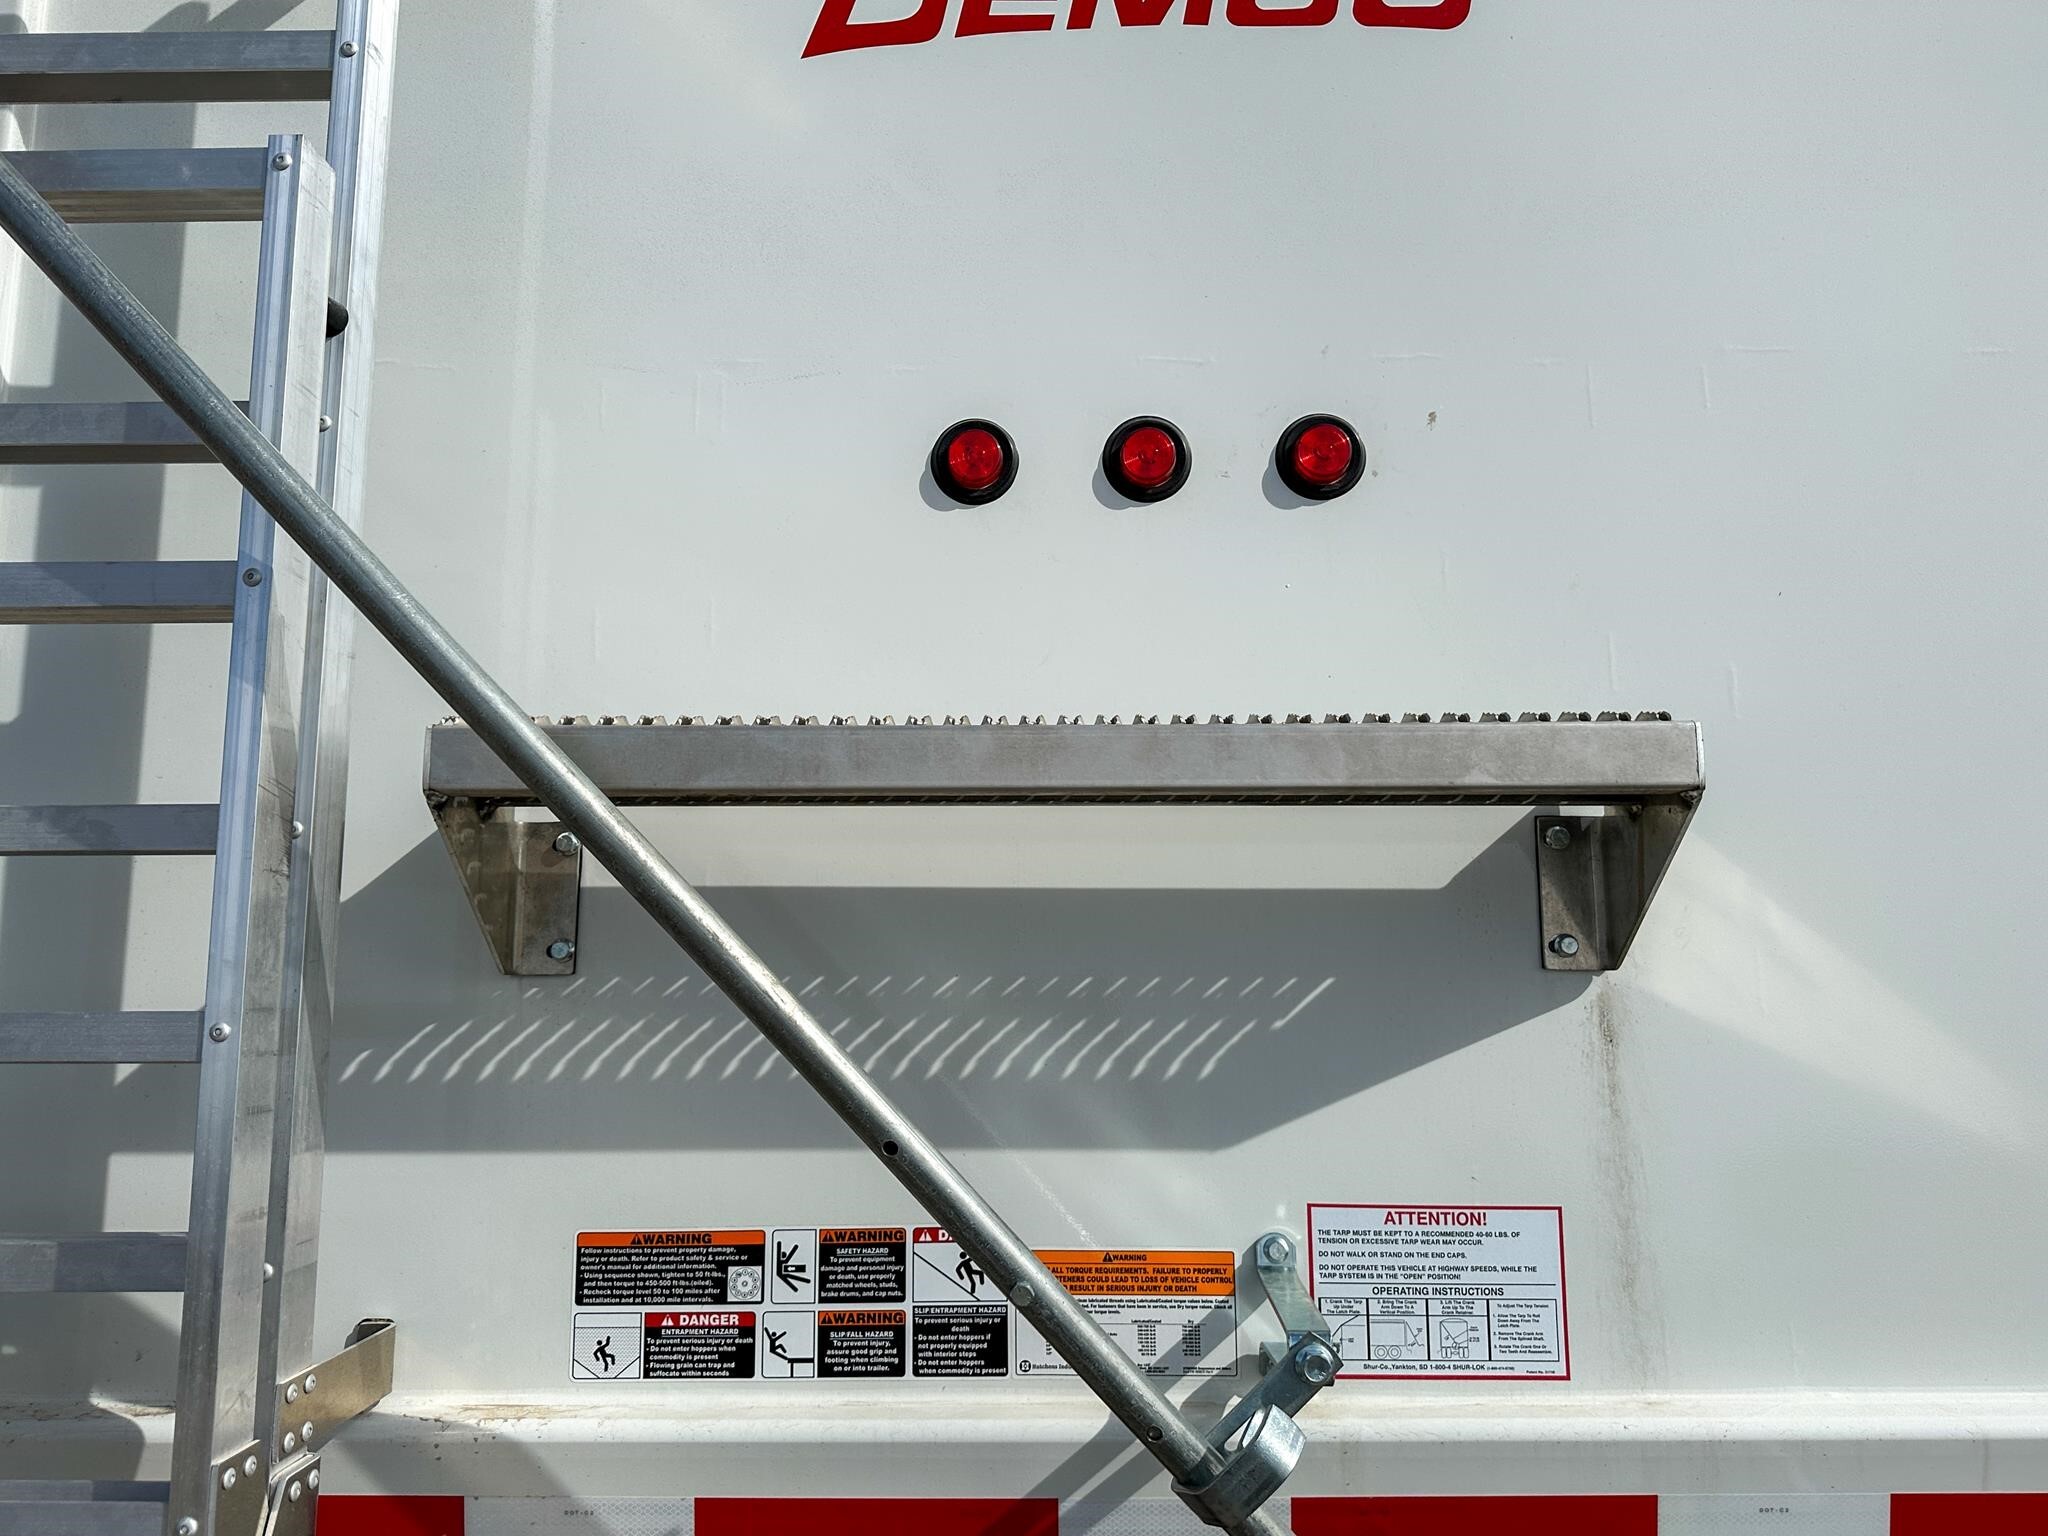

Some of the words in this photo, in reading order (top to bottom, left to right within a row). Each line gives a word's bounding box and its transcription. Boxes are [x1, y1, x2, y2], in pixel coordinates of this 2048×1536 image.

[1384, 1212, 1486, 1225] ATTENTION!
[643, 1234, 712, 1244] WARNING
[834, 1231, 904, 1242] WARNING
[1372, 1287, 1429, 1296] OPERATING
[1432, 1287, 1504, 1296] INSTRUCTIONS
[680, 1315, 738, 1325] DANGER
[834, 1313, 904, 1324] WARNING
